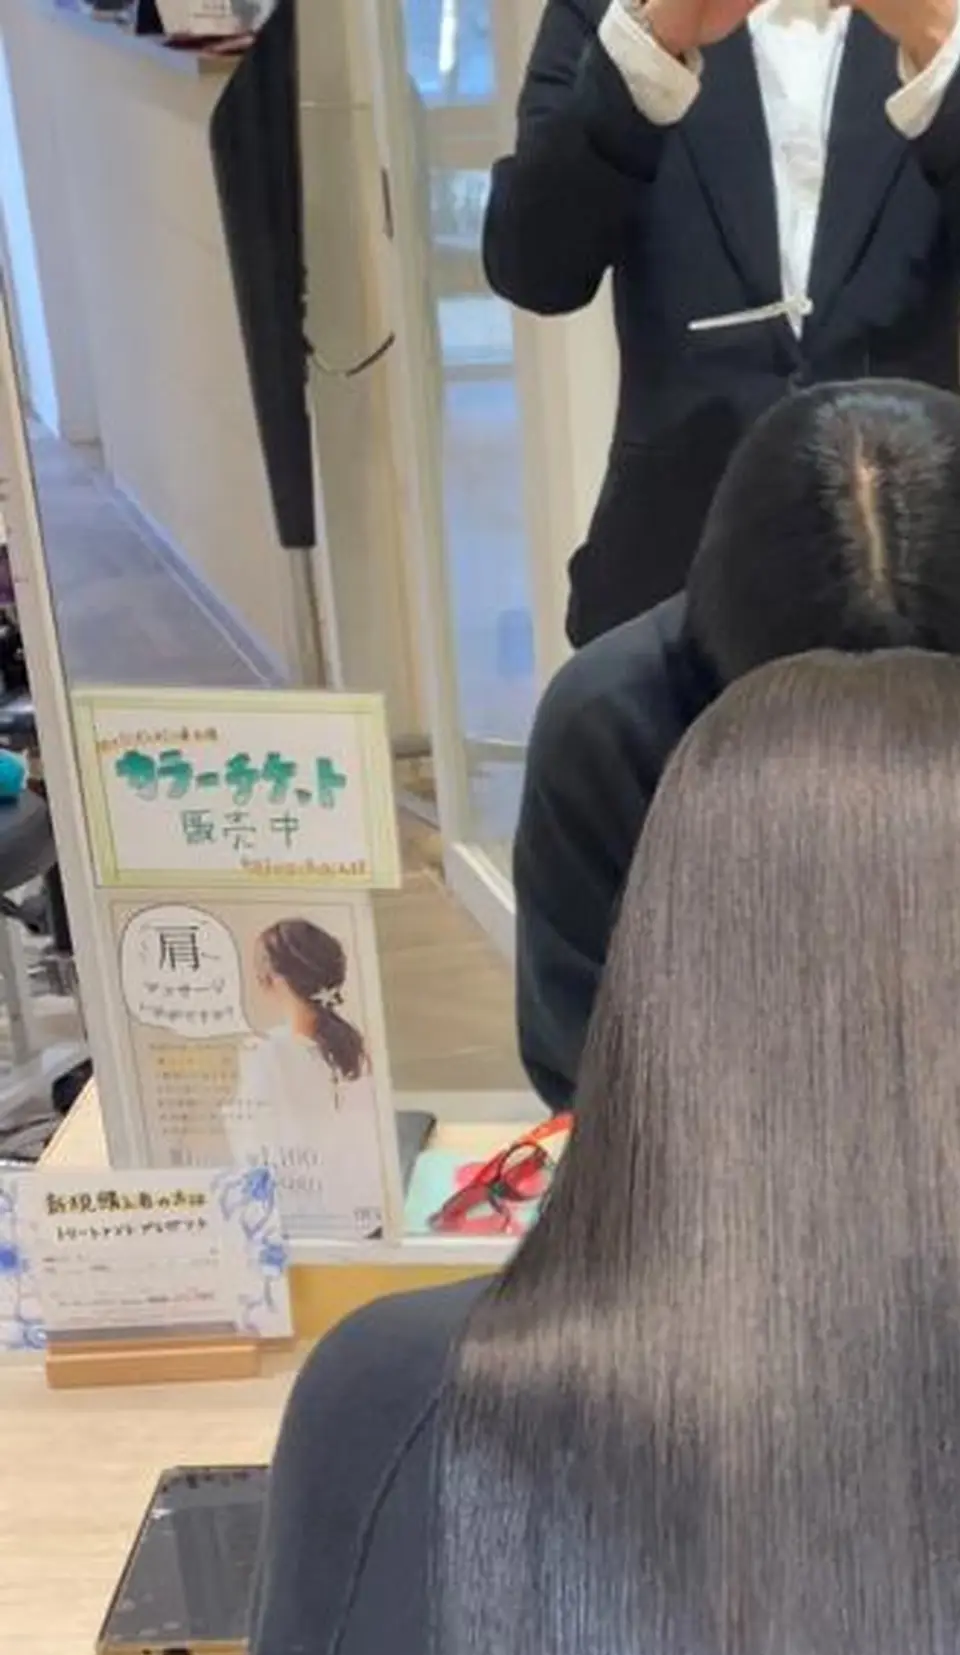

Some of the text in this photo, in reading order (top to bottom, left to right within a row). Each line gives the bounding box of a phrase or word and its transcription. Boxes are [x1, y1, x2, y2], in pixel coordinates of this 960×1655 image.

[115, 749, 347, 808] カラーチケット
[181, 809, 299, 850] 販売中
[153, 923, 200, 972] 肩
